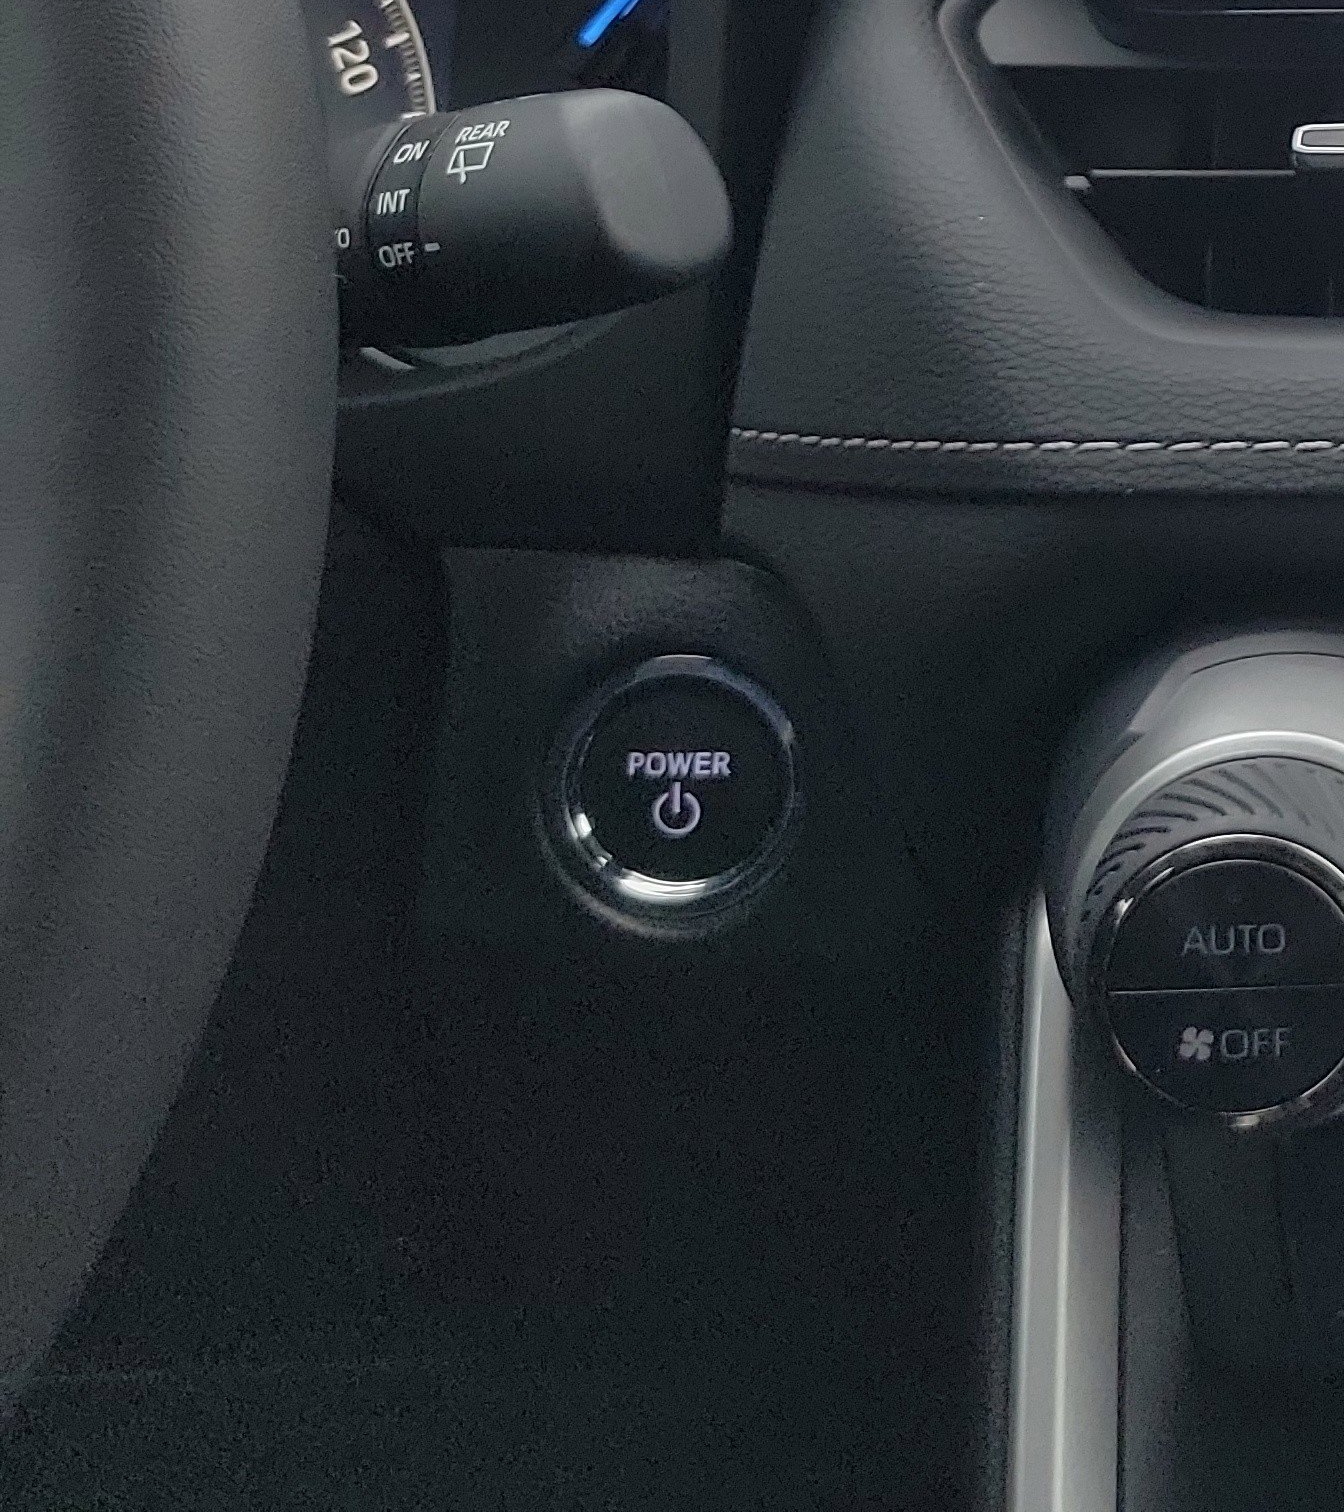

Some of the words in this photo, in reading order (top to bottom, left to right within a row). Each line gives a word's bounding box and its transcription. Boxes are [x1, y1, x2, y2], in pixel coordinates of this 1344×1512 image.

[327, 19, 380, 96] 120
[454, 119, 511, 145] REAR
[393, 139, 431, 166] ON
[376, 187, 411, 216] INT
[378, 241, 416, 269] OFF
[627, 751, 733, 778] POWER
[1180, 922, 1286, 956] AUTO
[1220, 1028, 1291, 1059] OFF
